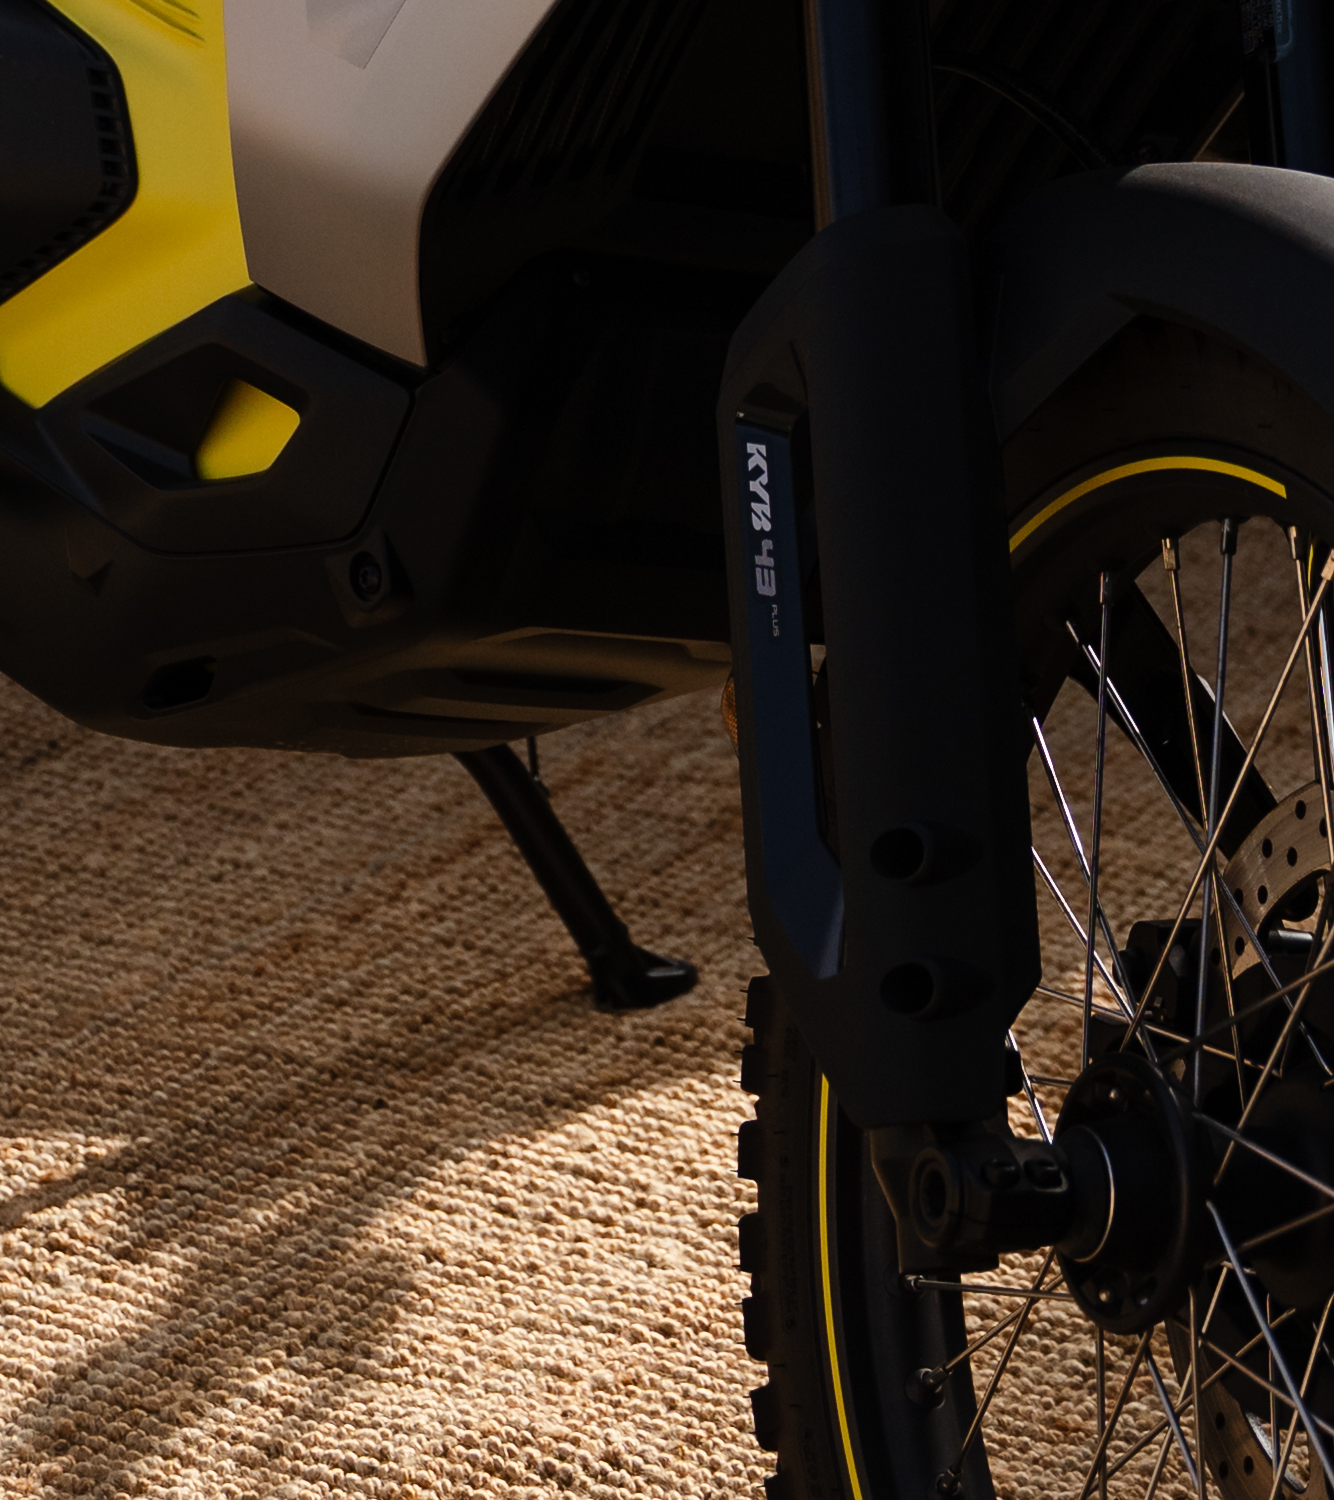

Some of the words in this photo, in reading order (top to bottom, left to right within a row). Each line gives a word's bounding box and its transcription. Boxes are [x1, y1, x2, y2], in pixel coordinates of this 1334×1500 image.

[746, 442, 772, 532] KYB
[754, 538, 777, 598] 43
[770, 604, 780, 638] PLUS
